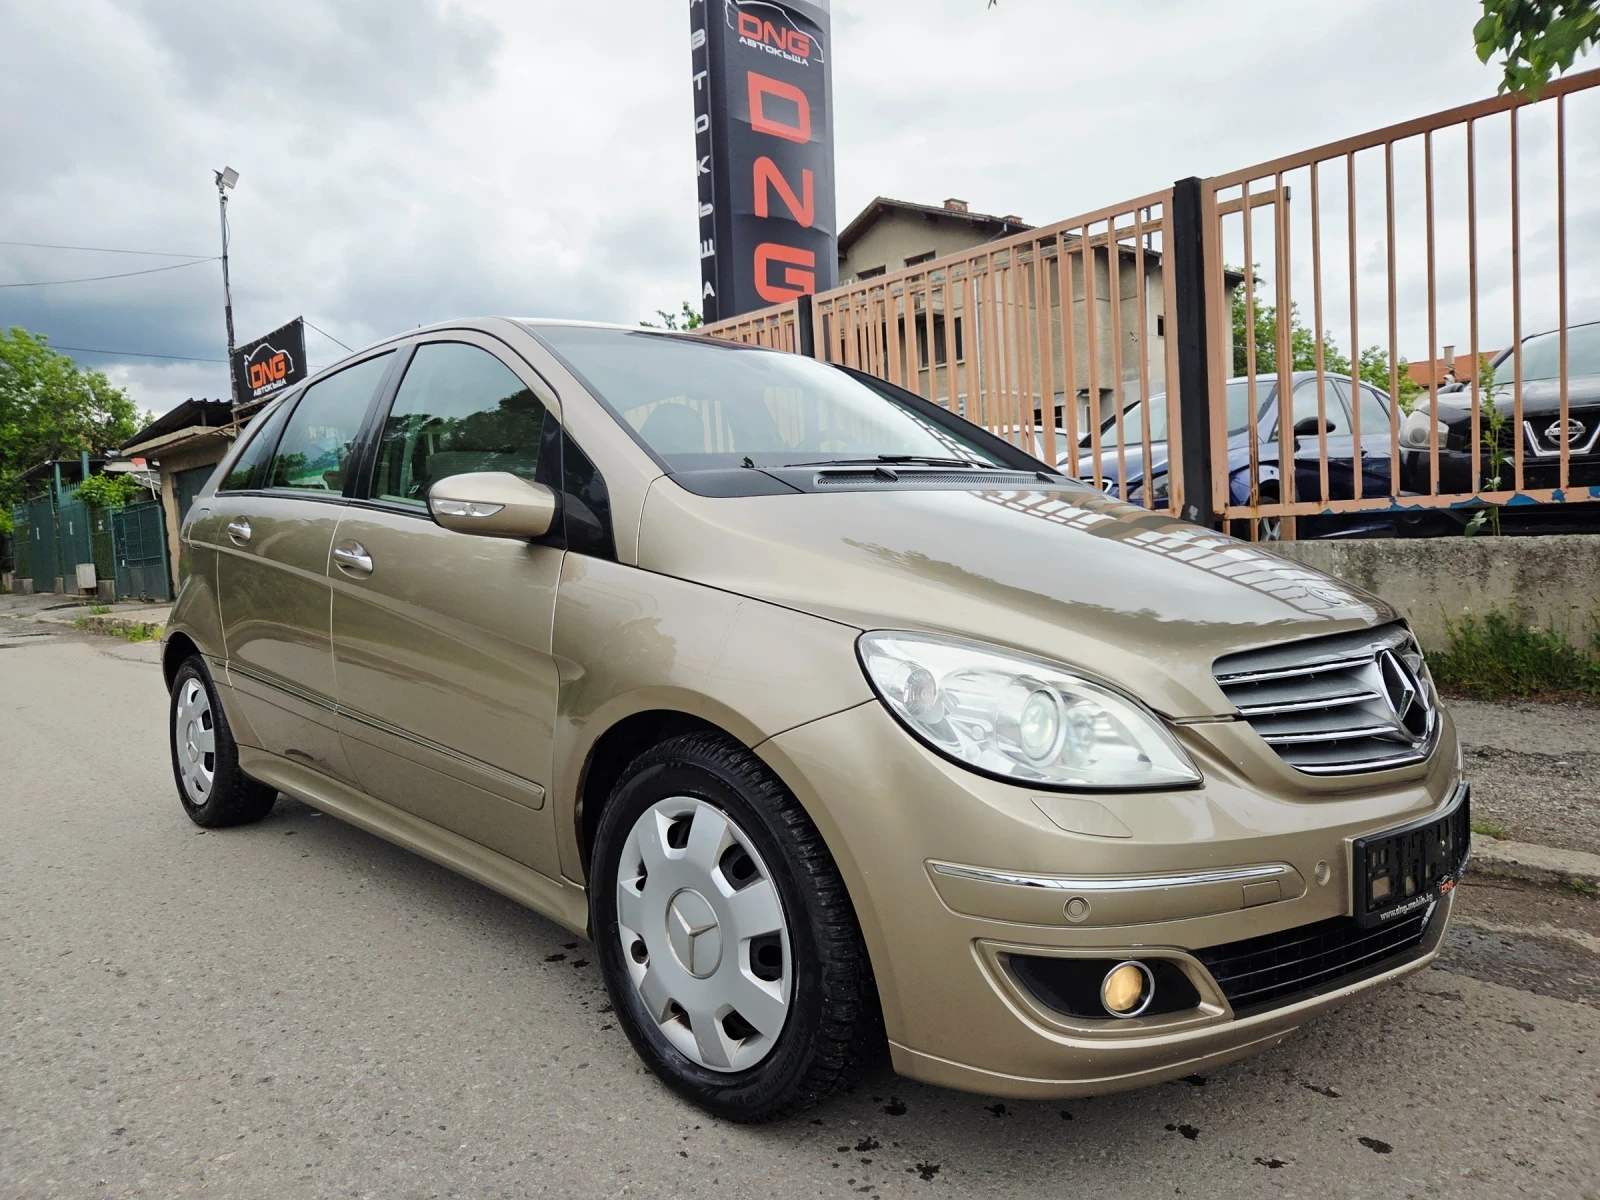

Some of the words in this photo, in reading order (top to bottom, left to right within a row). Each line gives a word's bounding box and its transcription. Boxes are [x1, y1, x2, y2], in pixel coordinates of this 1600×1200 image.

[737, 11, 810, 58] DNG
[738, 36, 809, 67] АВТОКЪША
[747, 70, 815, 303] DNG
[250, 353, 285, 388] DNG
